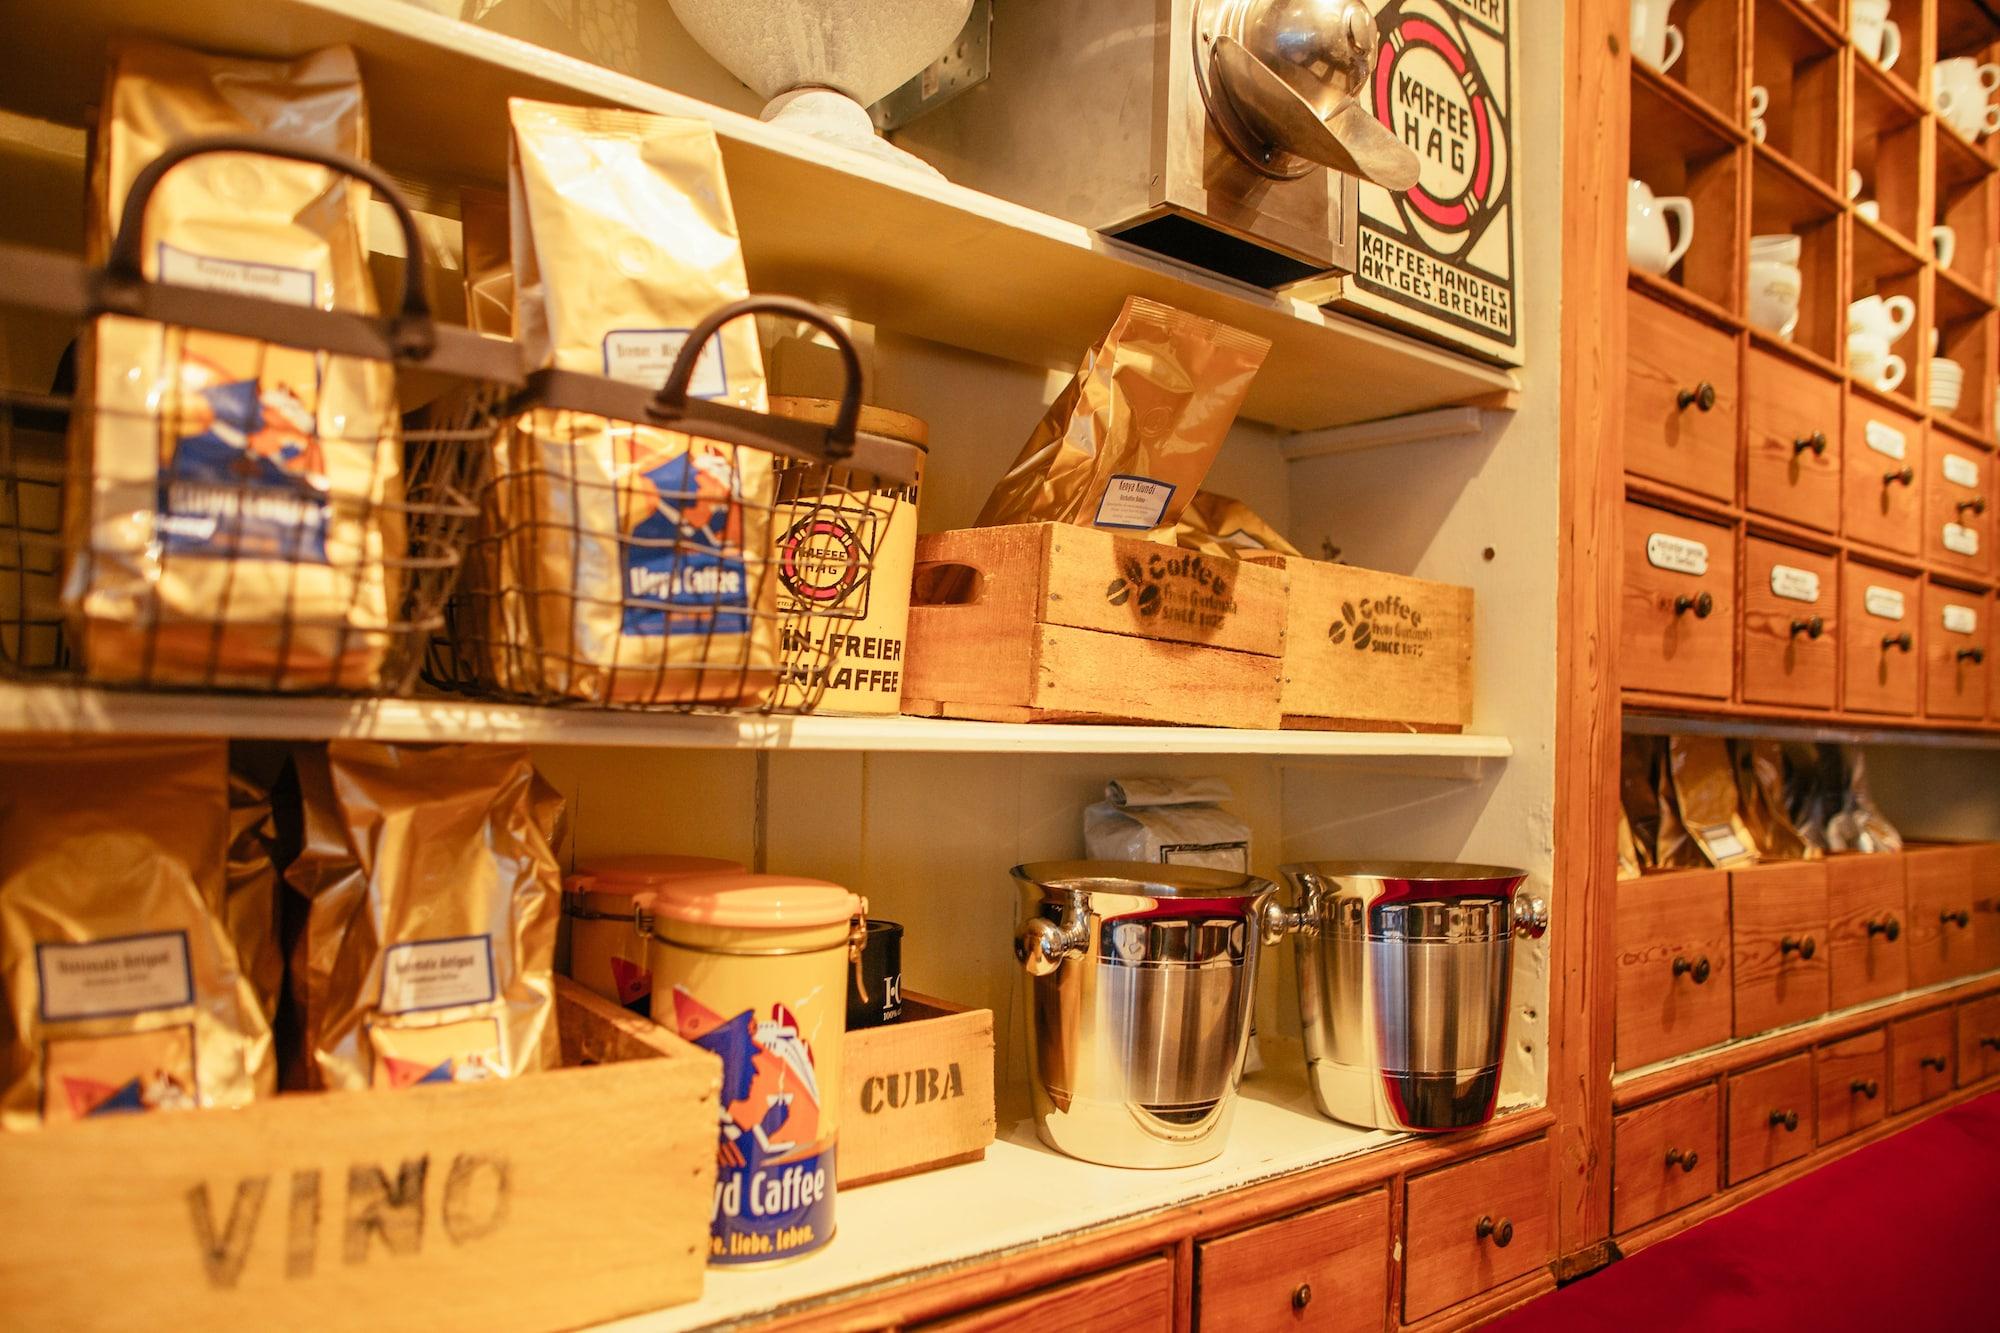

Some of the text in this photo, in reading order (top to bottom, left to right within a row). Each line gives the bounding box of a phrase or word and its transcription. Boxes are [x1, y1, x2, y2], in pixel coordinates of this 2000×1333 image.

[1399, 70, 1469, 140] KAFFEE
[1404, 111, 1464, 175] HAG
[1359, 595, 1421, 627] Coffee
[861, 1062, 964, 1114] CUBA
[750, 1165, 825, 1216] Caffee
[185, 1152, 512, 1290] VINO
[730, 1231, 773, 1255] Liebe.
